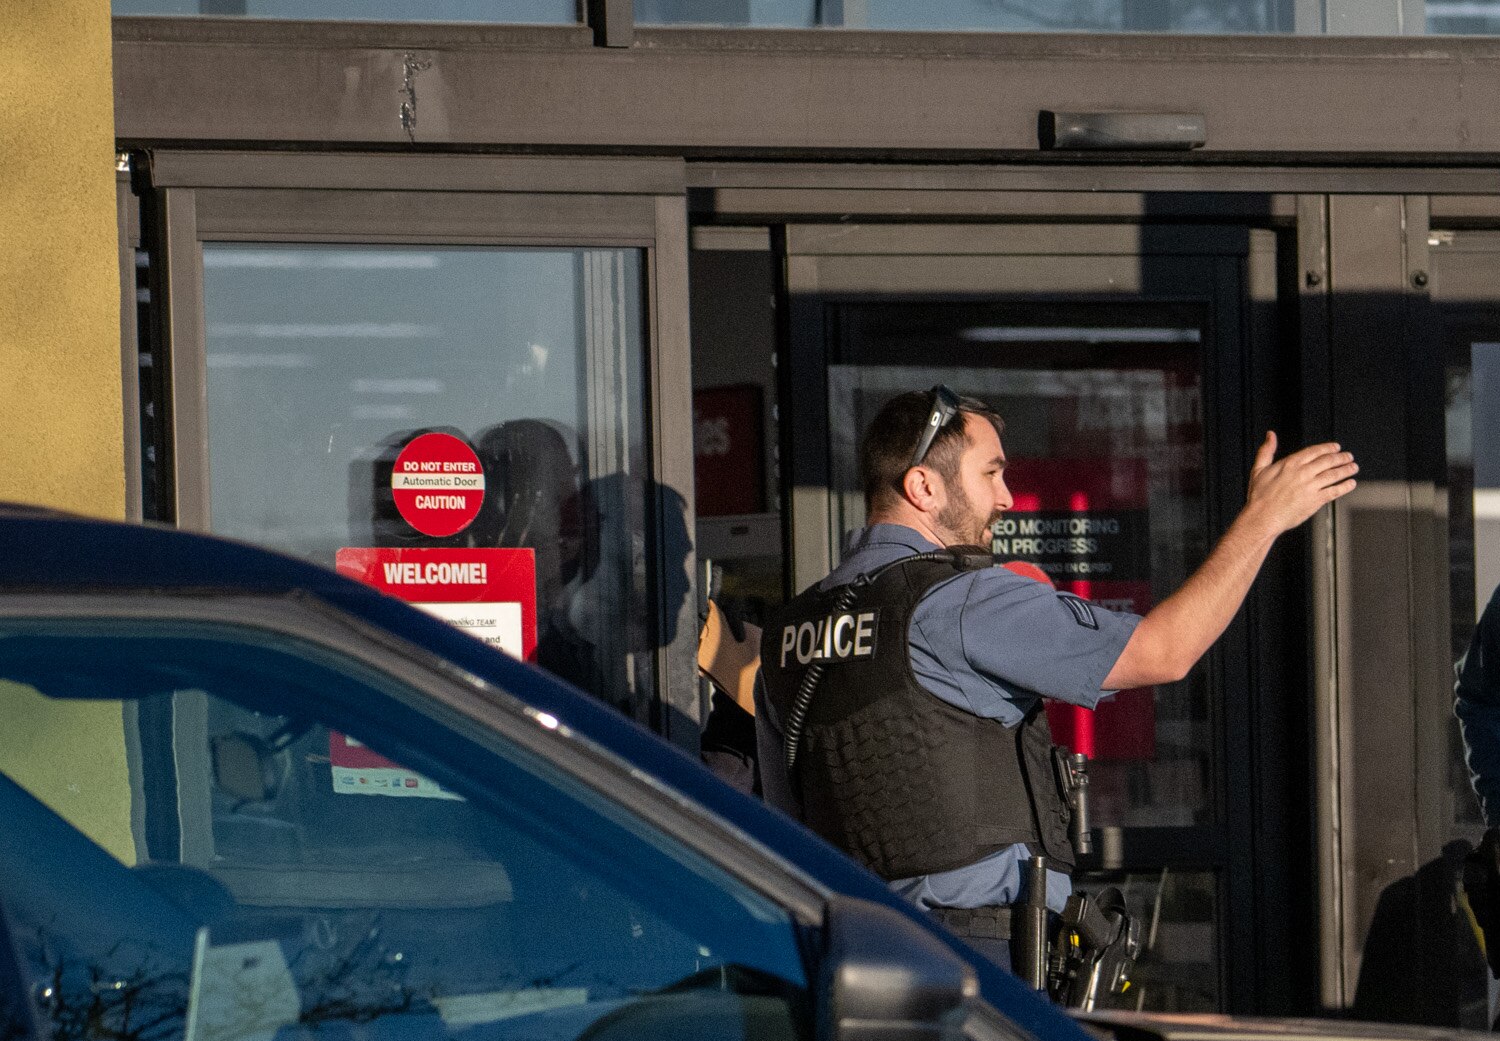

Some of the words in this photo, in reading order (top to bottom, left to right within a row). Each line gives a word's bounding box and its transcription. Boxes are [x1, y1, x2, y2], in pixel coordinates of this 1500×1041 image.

[403, 461, 419, 471] DO
[420, 461, 441, 471] NOT
[443, 462, 476, 472] ENTER
[402, 477, 452, 486] Automatic
[454, 477, 477, 486] Door
[415, 495, 466, 510] CAUTION
[992, 538, 1008, 554] IN
[1012, 538, 1098, 554] PROGRESS
[383, 562, 487, 585] WELCOME!
[780, 612, 874, 668] POLICE
